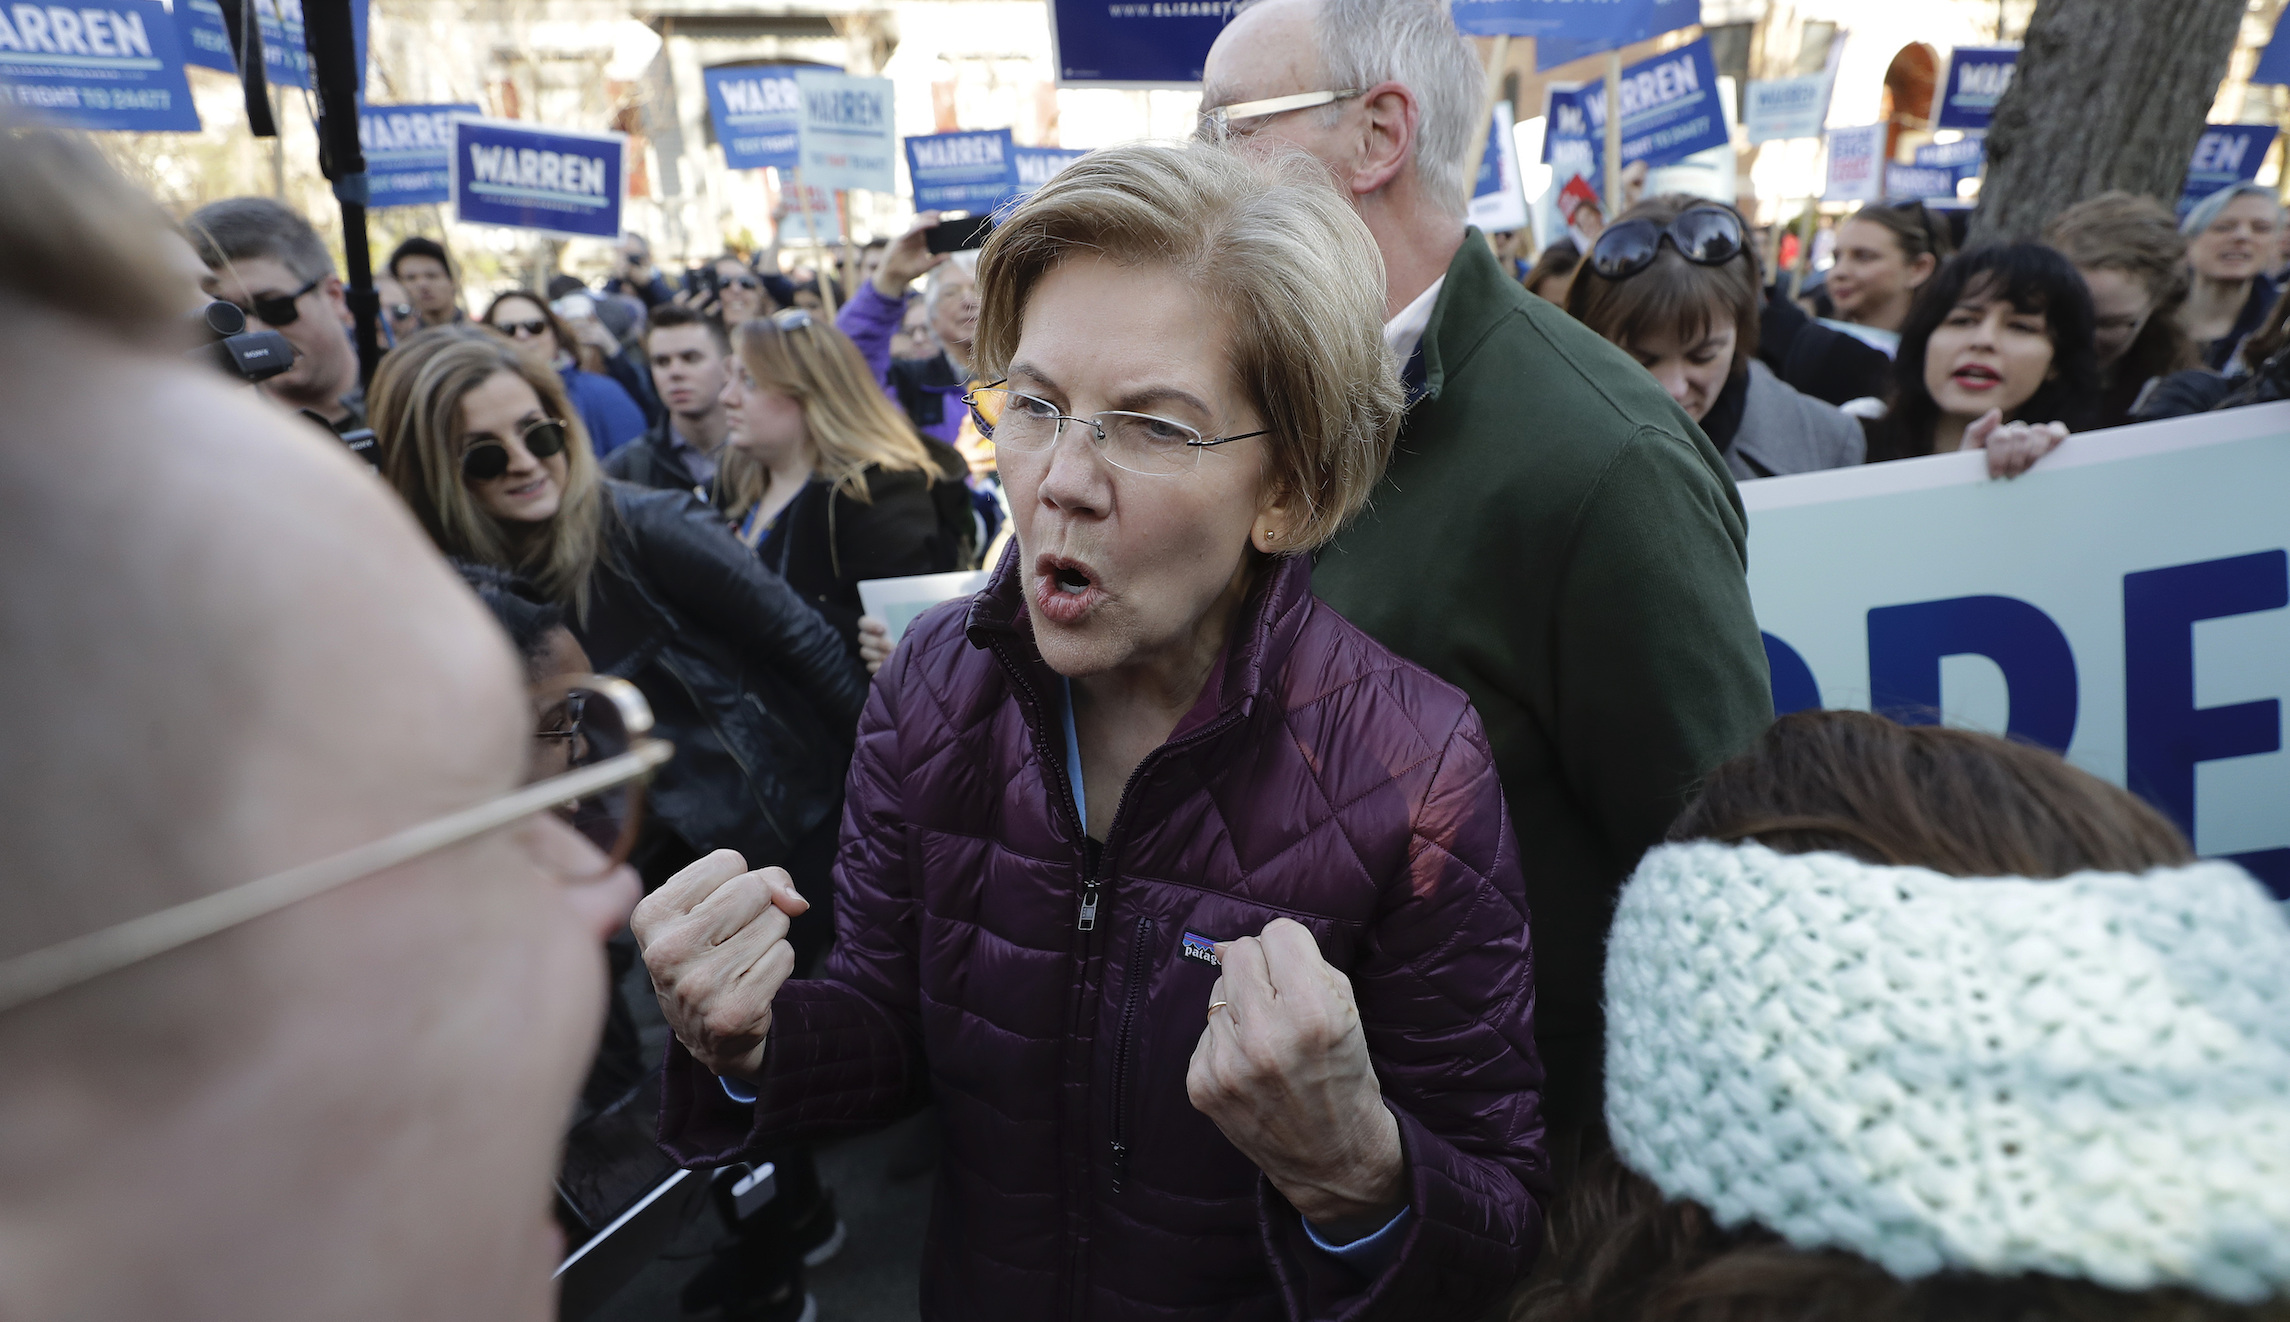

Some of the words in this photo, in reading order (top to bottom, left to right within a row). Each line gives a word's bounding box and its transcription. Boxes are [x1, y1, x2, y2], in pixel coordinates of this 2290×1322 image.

[1584, 53, 1699, 127] WRREN
[469, 142, 606, 195] WARREN
[1185, 946, 1222, 966] patag
